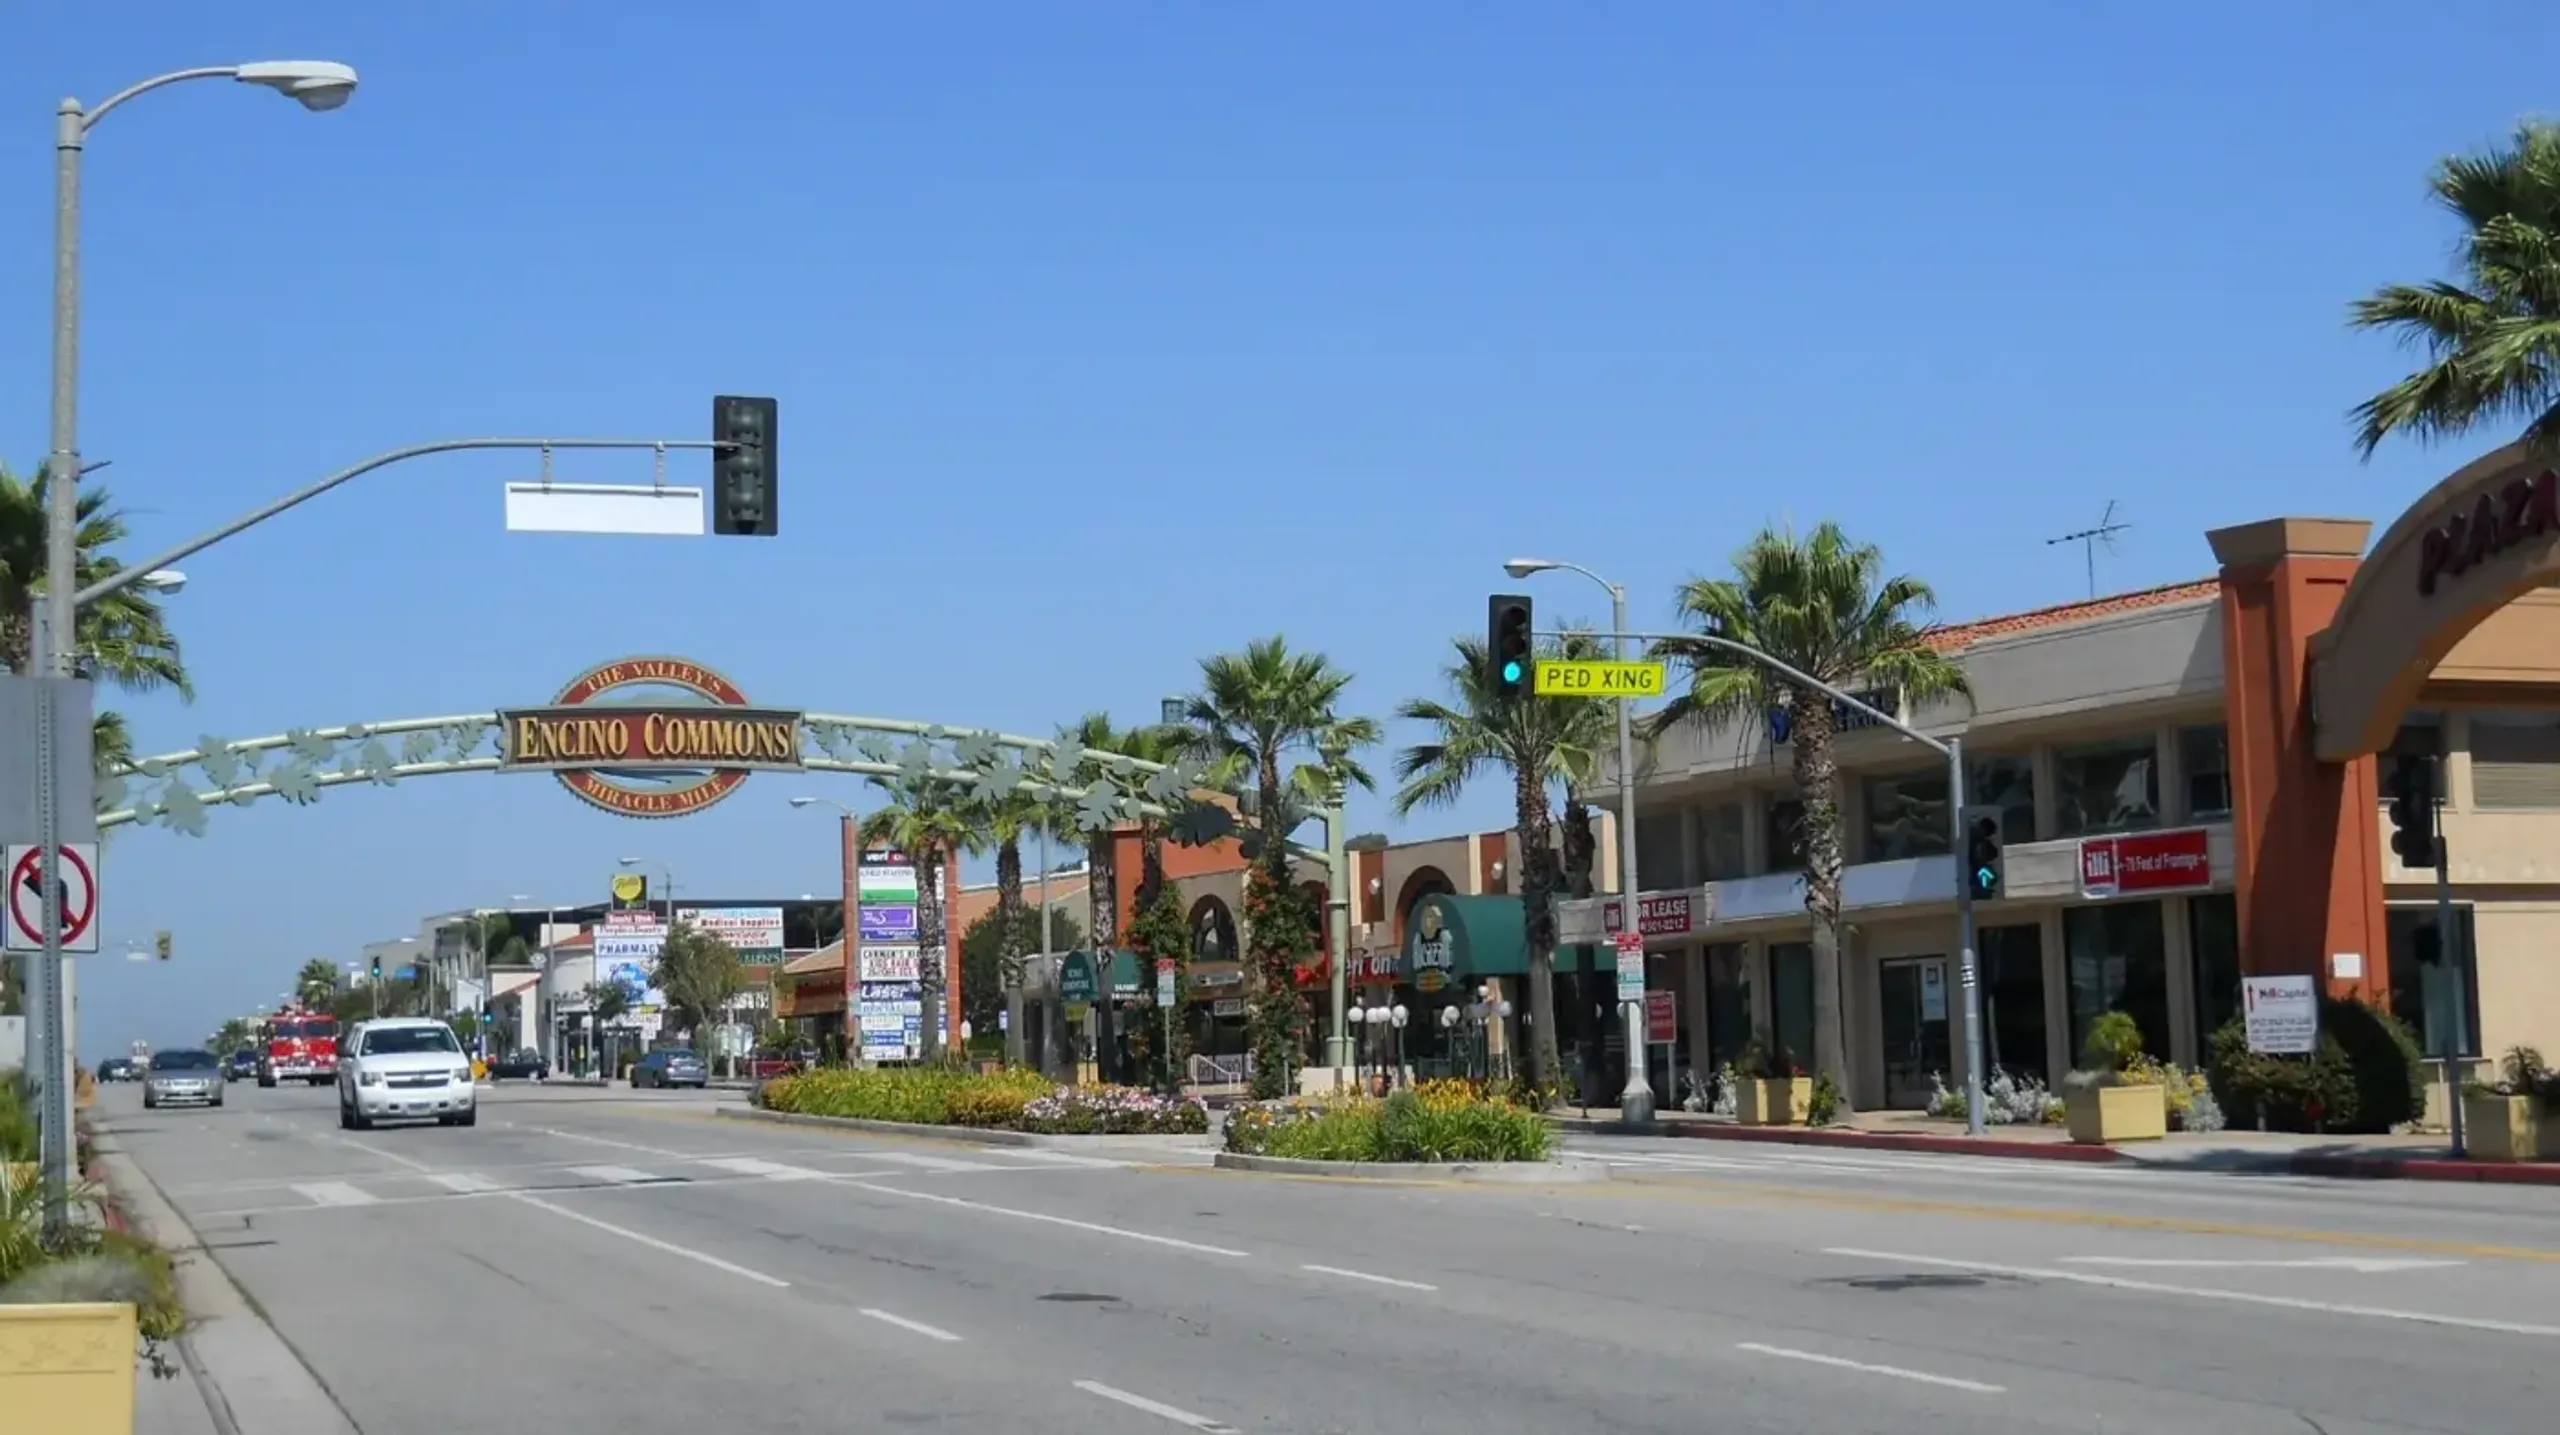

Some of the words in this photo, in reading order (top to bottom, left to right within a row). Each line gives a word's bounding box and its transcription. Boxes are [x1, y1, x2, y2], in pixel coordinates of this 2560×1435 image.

[584, 664, 625, 693] THE
[631, 661, 724, 695] VALLEY'S
[1547, 668, 1590, 688] PED
[1602, 669, 1652, 689] XING
[517, 715, 629, 759] ENCINO
[644, 712, 791, 758] COMMONS
[582, 778, 674, 810] MIRACLE
[678, 777, 728, 807] MILE
[1652, 899, 1688, 917] LEASE
